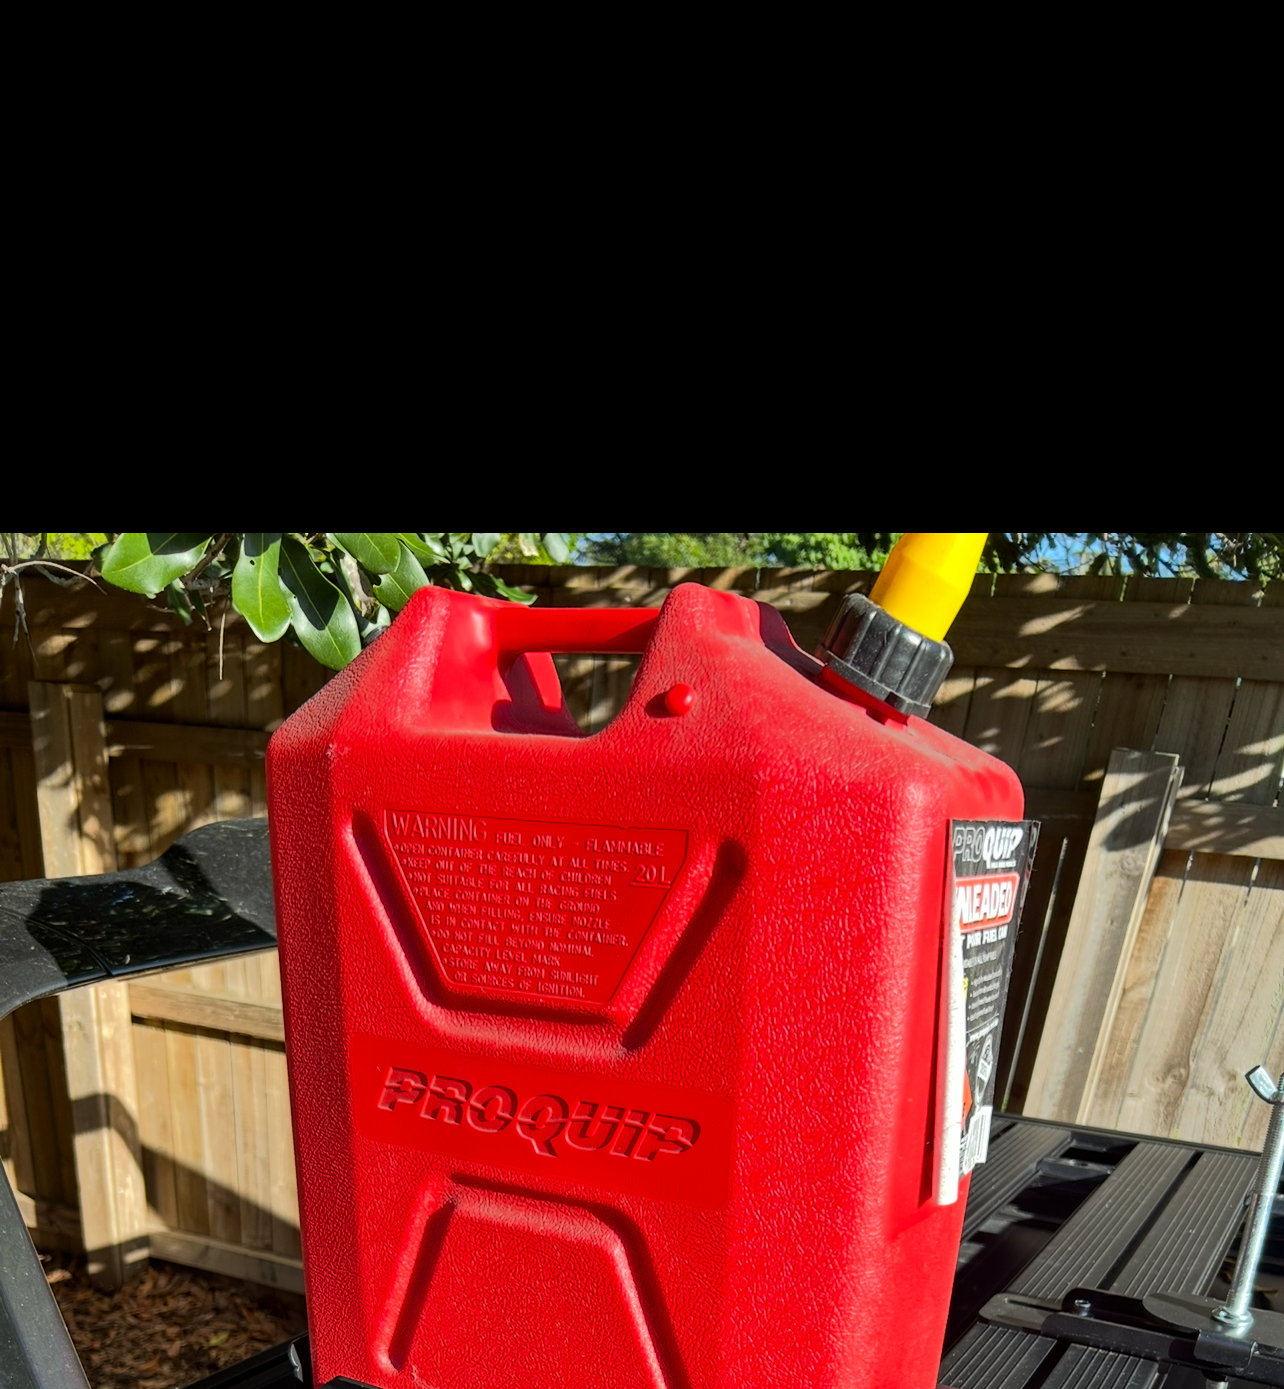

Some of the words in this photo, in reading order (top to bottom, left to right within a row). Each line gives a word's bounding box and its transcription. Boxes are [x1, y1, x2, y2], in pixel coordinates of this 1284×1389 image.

[391, 812, 488, 843] WARNING
[495, 831, 525, 847] FUEL
[532, 834, 565, 849] ONLY
[585, 838, 665, 857] FLAMMABLE
[953, 826, 1024, 869] PROQUIP
[400, 842, 425, 855] OPEN
[428, 845, 483, 861] CONTAINER
[487, 850, 545, 866] CAREFULLY
[549, 855, 564, 868] AT
[568, 857, 589, 870] ALL
[594, 858, 630, 873] TIMES.
[407, 857, 431, 870] KEEP
[435, 859, 455, 872] OUT
[459, 862, 474, 874] OF
[478, 863, 498, 877] THE
[502, 866, 537, 880] REACH
[541, 869, 555, 881] OF
[560, 870, 612, 886] CHILDREN
[413, 872, 433, 884] NOT
[436, 874, 485, 889] SUITABLE
[489, 879, 510, 891] FOR
[514, 881, 534, 894] ALL
[539, 883, 579, 898] RACING
[419, 886, 450, 900] PLACE
[454, 889, 511, 905] CONTAINER
[515, 895, 530, 907] ON
[535, 897, 553, 910] THE
[559, 900, 601, 914] GROUND
[956, 881, 1013, 924] NLEADED
[425, 901, 445, 912] AND
[449, 902, 477, 916] WHEN
[481, 906, 525, 923] FILLING,
[529, 911, 567, 926] ENSURE
[571, 915, 611, 930] NOZZLE
[430, 914, 441, 926] IS
[446, 916, 457, 928] IN
[460, 918, 506, 932] CONTACT
[511, 923, 539, 937] WITH
[543, 926, 562, 939] THE
[567, 929, 629, 947] CONTAINER.
[436, 929, 450, 940] DO
[454, 930, 473, 943] NOT
[477, 933, 500, 946] FILL
[505, 936, 545, 950] BEYOND
[549, 941, 594, 958] NOMINAL
[442, 943, 491, 958] CAPACITY
[496, 949, 527, 963] LEVEL
[448, 956, 479, 971] STORE
[483, 960, 513, 975] AWAY
[516, 965, 546, 979] FROM
[550, 969, 600, 986] SUNLIGHT
[454, 971, 468, 983] OR
[471, 974, 515, 989] SOURCES
[519, 979, 533, 991] OF
[536, 981, 586, 999] IGNITION.
[377, 1066, 702, 1162] PROQUIP
